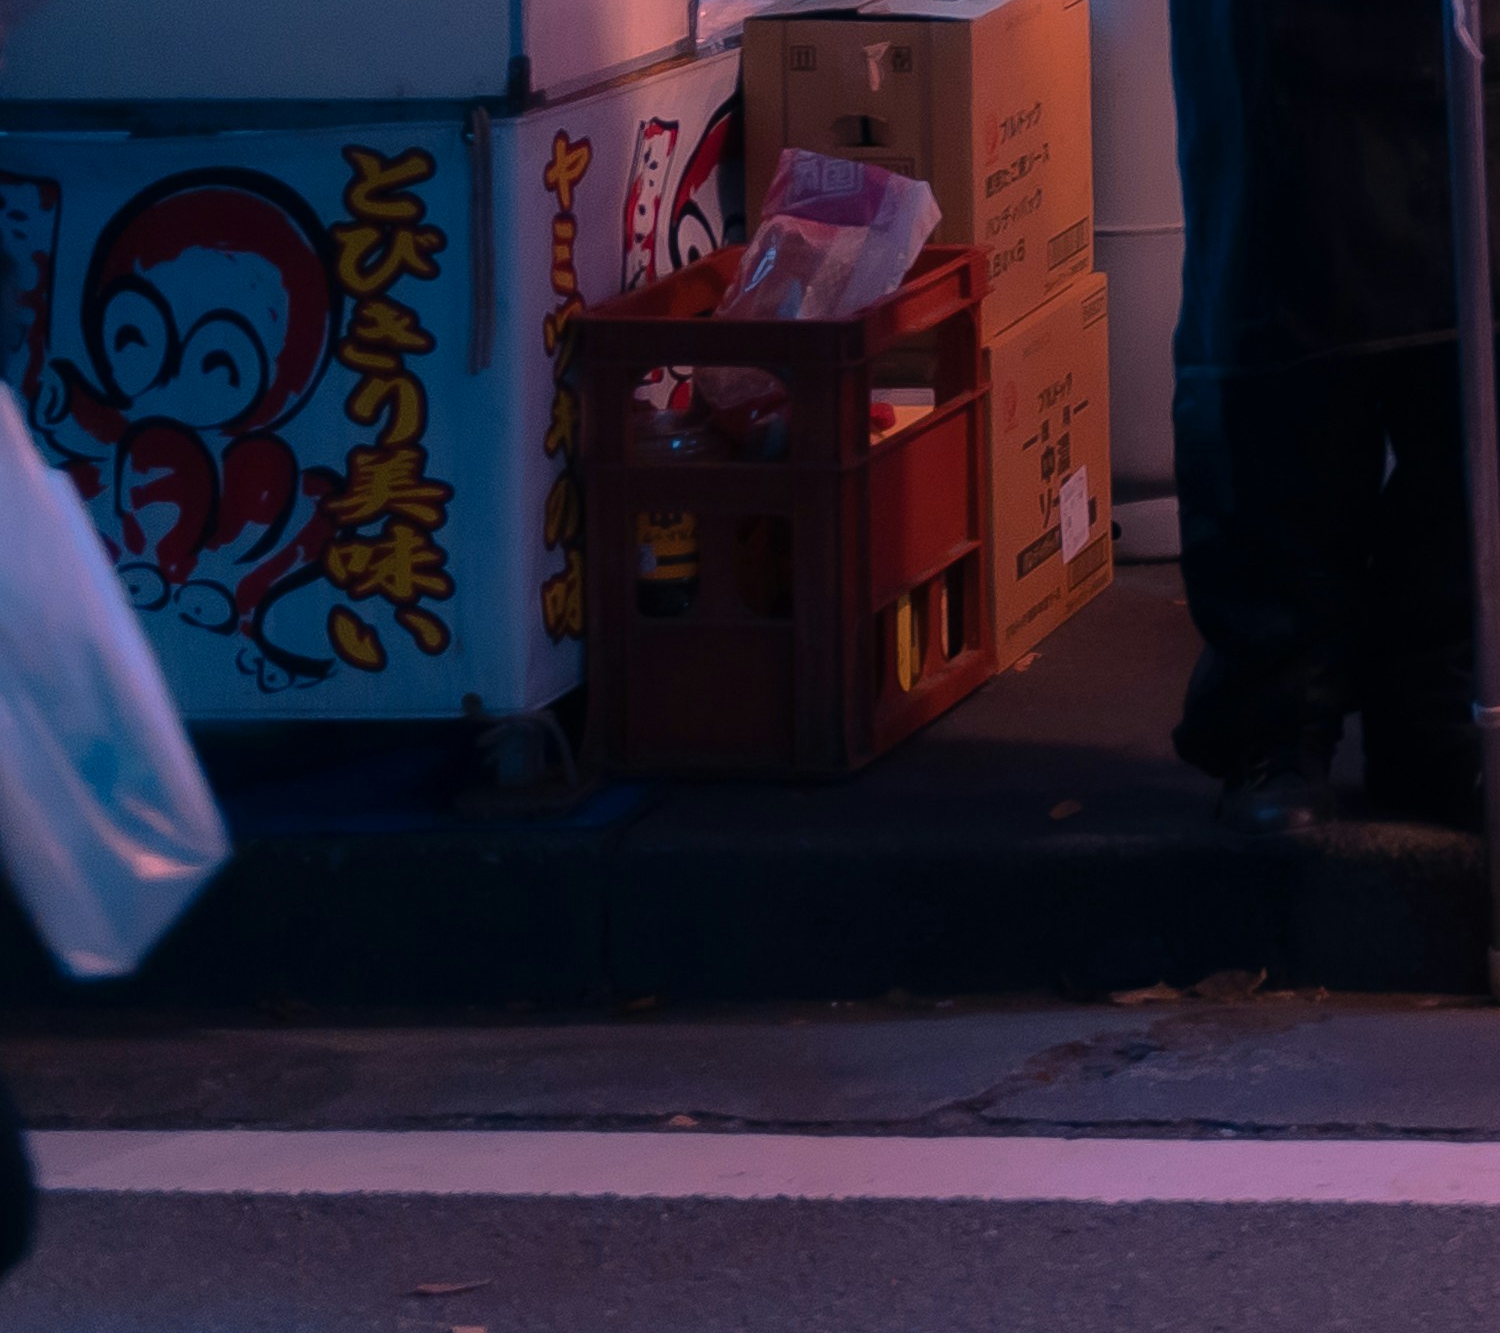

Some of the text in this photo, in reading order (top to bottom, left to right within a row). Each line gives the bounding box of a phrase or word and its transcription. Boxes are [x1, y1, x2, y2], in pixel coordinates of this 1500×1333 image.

[324, 145, 456, 672] とびきり美味い
